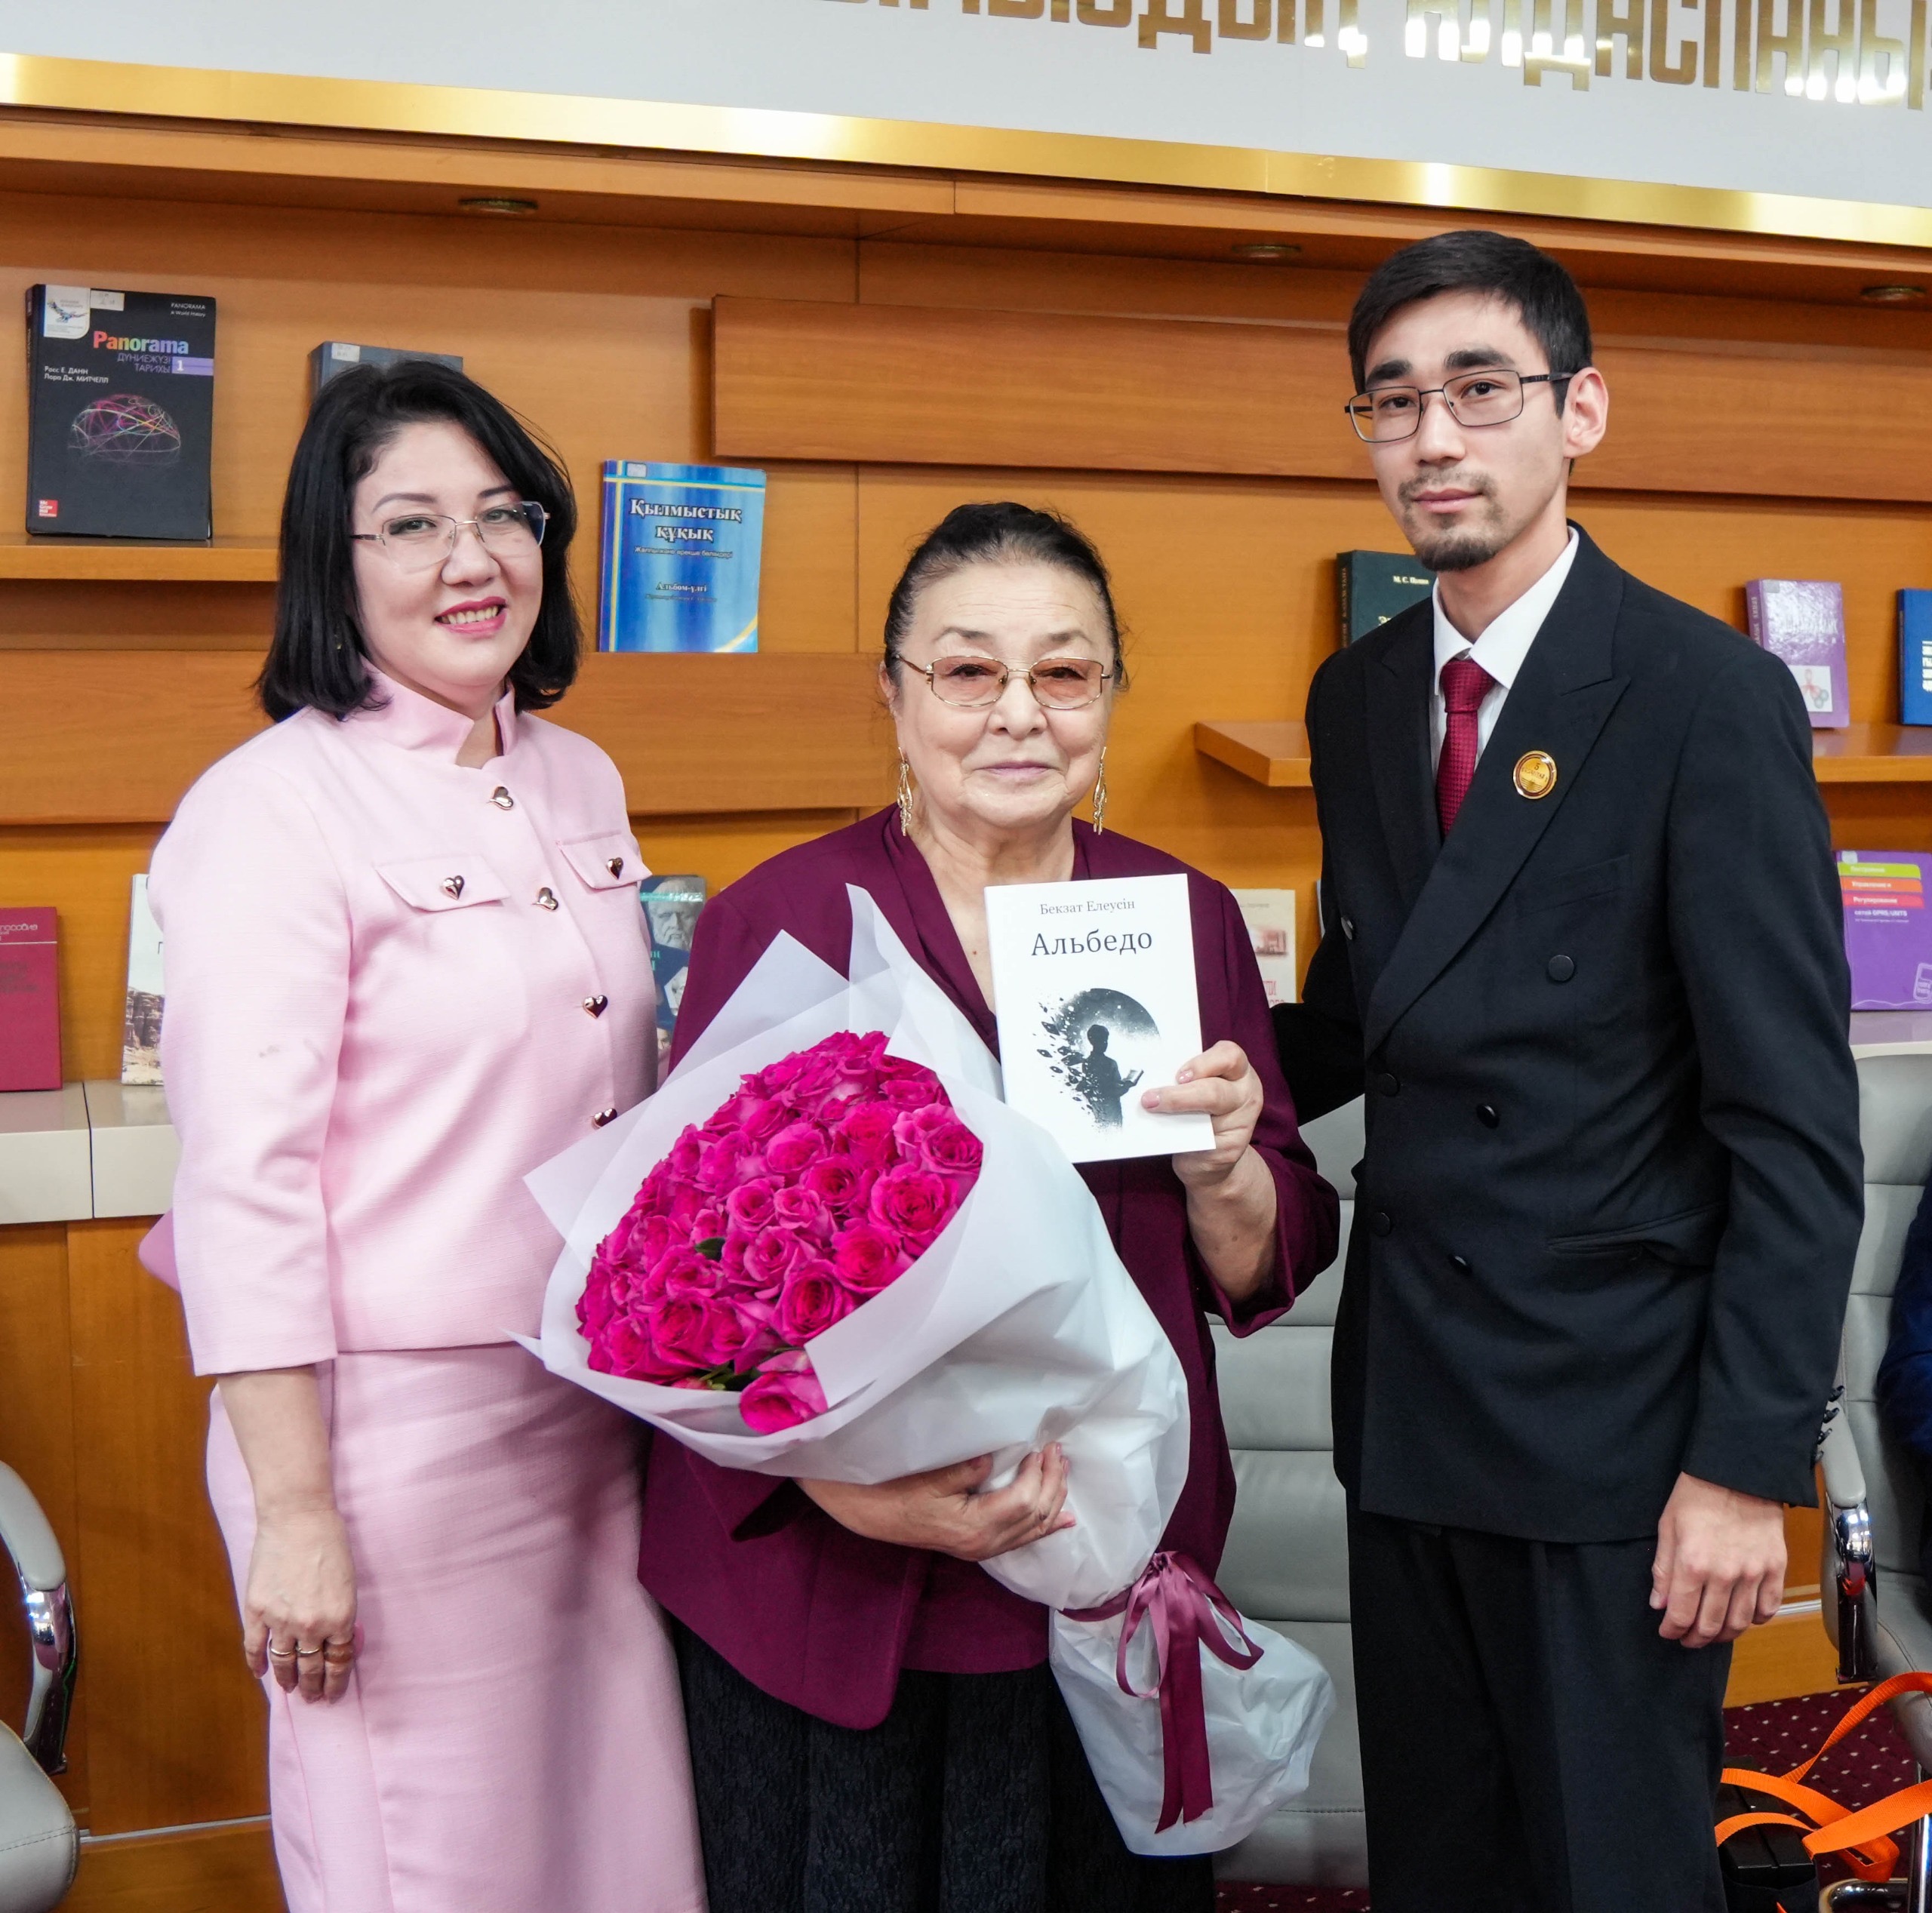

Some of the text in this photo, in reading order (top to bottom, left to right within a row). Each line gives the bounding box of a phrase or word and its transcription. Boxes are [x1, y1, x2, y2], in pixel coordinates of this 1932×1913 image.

[1405, 0, 1932, 110] АЛДАСПАНЫ
[93, 331, 189, 355] Panorama
[134, 364, 171, 374] ТАРИХЫ
[177, 359, 184, 371] 1
[44, 373, 61, 381] Лора
[76, 376, 109, 384] МИТЧЕЛЛ
[629, 498, 743, 523] Қылмыстық
[656, 525, 714, 543] құқық
[656, 581, 707, 593] Альбом-үлгі
[1039, 897, 1135, 915] Бекзат Елеусін
[1030, 928, 1153, 956] Альбедо
